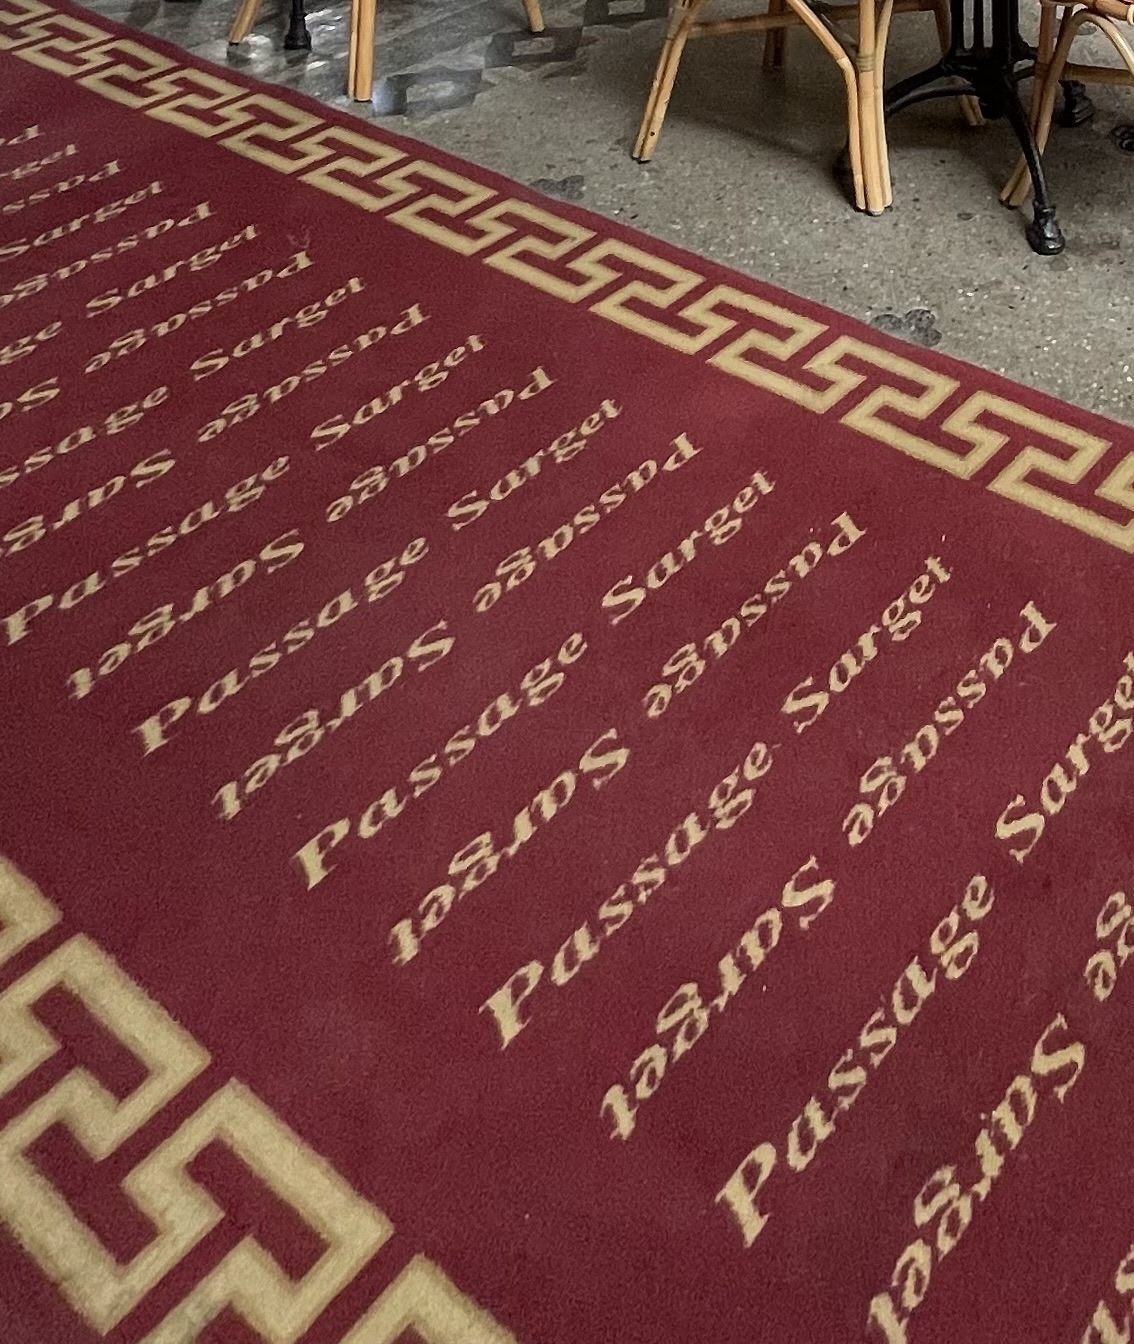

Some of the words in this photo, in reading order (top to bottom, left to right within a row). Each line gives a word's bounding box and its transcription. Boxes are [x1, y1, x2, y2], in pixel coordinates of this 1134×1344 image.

[85, 249, 313, 373] Passage
[86, 225, 257, 318] Sarget
[190, 277, 364, 381] Sarget
[198, 303, 429, 442] Passage
[0, 455, 289, 645] Passage
[310, 335, 484, 451] Sarget
[326, 366, 554, 523] Passage
[473, 432, 701, 613] Passage
[67, 529, 304, 699] Sarget
[133, 537, 429, 756] Passage
[446, 399, 622, 531] Sarget
[293, 633, 588, 890] Passage
[601, 471, 775, 625] Sarget
[643, 511, 866, 719] Passage
[211, 620, 455, 820] Sarget
[479, 742, 773, 1050] Passage
[780, 556, 951, 734] Sarget
[842, 601, 1057, 847] Passage
[388, 728, 631, 966] Sarget
[600, 855, 836, 1140] Sarget
[714, 873, 995, 1248] Passage
